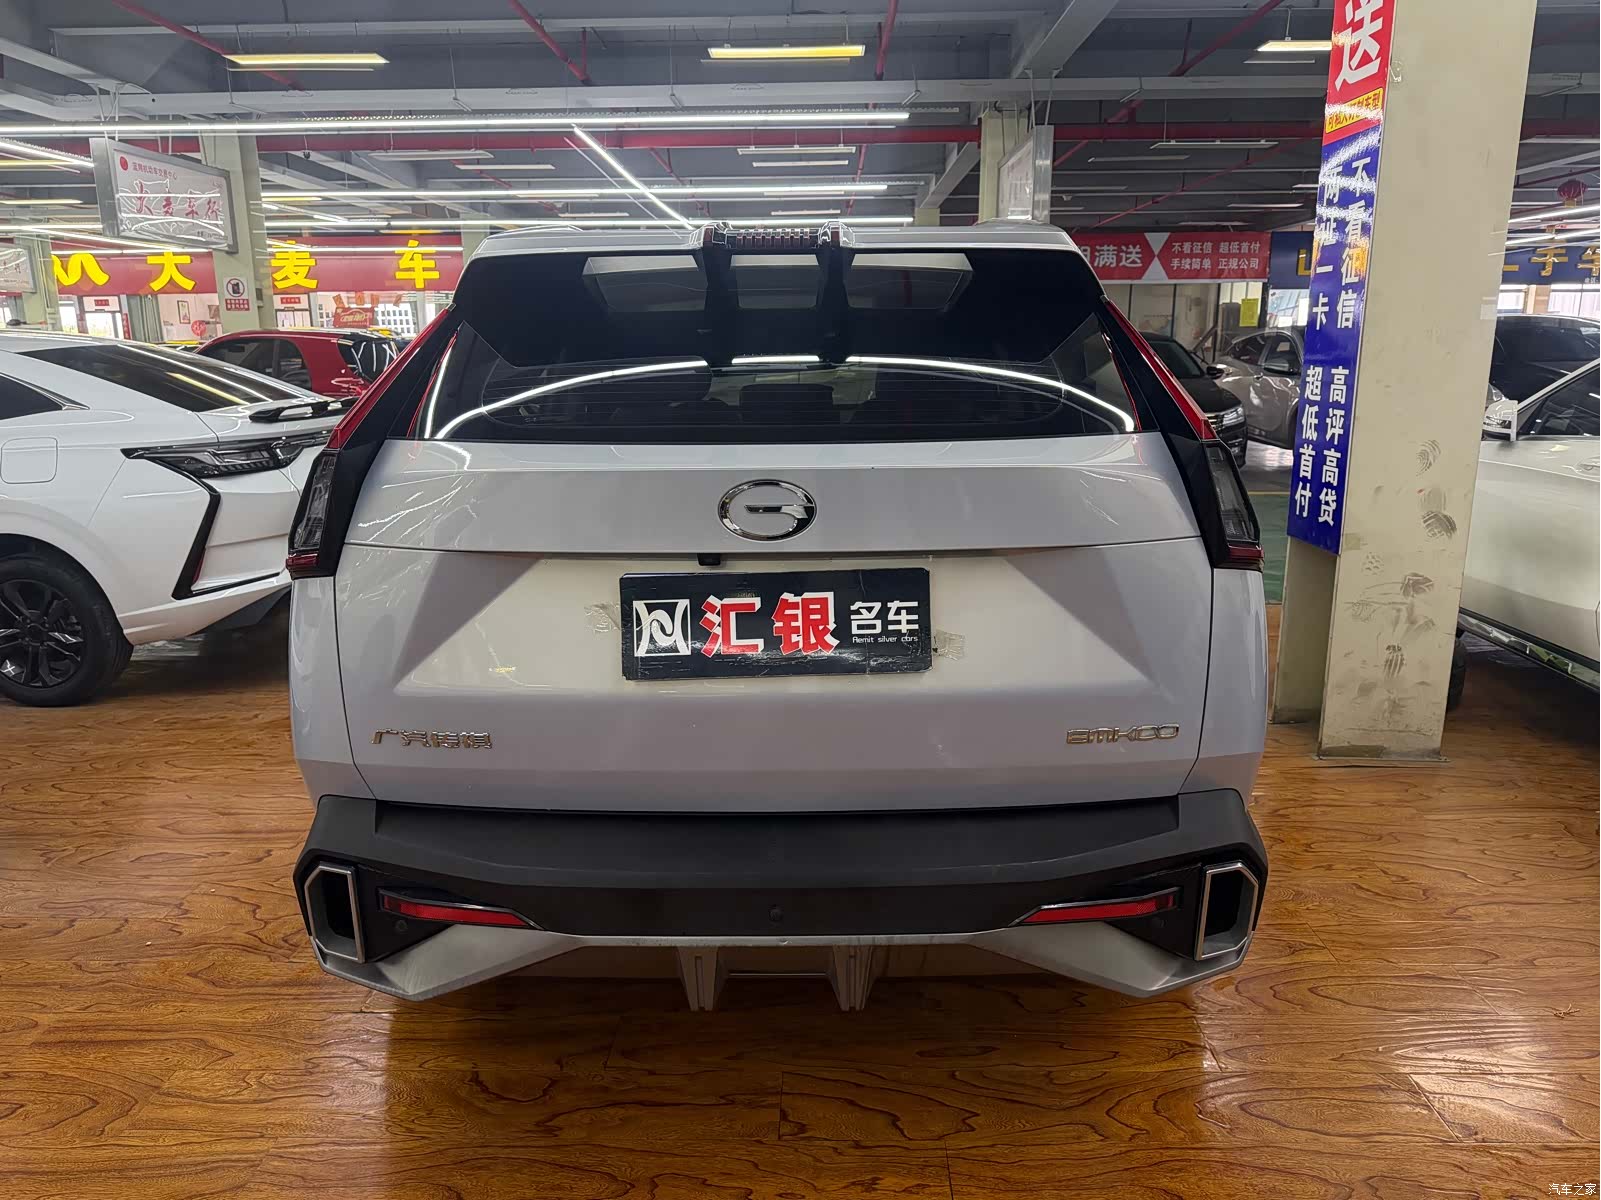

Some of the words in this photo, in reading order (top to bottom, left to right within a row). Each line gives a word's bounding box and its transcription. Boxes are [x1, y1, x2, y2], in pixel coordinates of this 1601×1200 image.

[1334, 0, 1383, 91] 送
[1170, 258, 1211, 271] 手续简单
[1218, 258, 1259, 270] 正规公司
[1171, 241, 1213, 255] 不看征信
[1219, 241, 1261, 254] 超低首付
[1312, 166, 1343, 331] 两证一卡
[1336, 157, 1371, 329] 不看征信
[1295, 365, 1323, 518] 超低首付
[1318, 365, 1350, 527] 高评高贷
[700, 591, 841, 658] 汇银
[850, 600, 919, 635] 名车
[877, 635, 898, 643] silver
